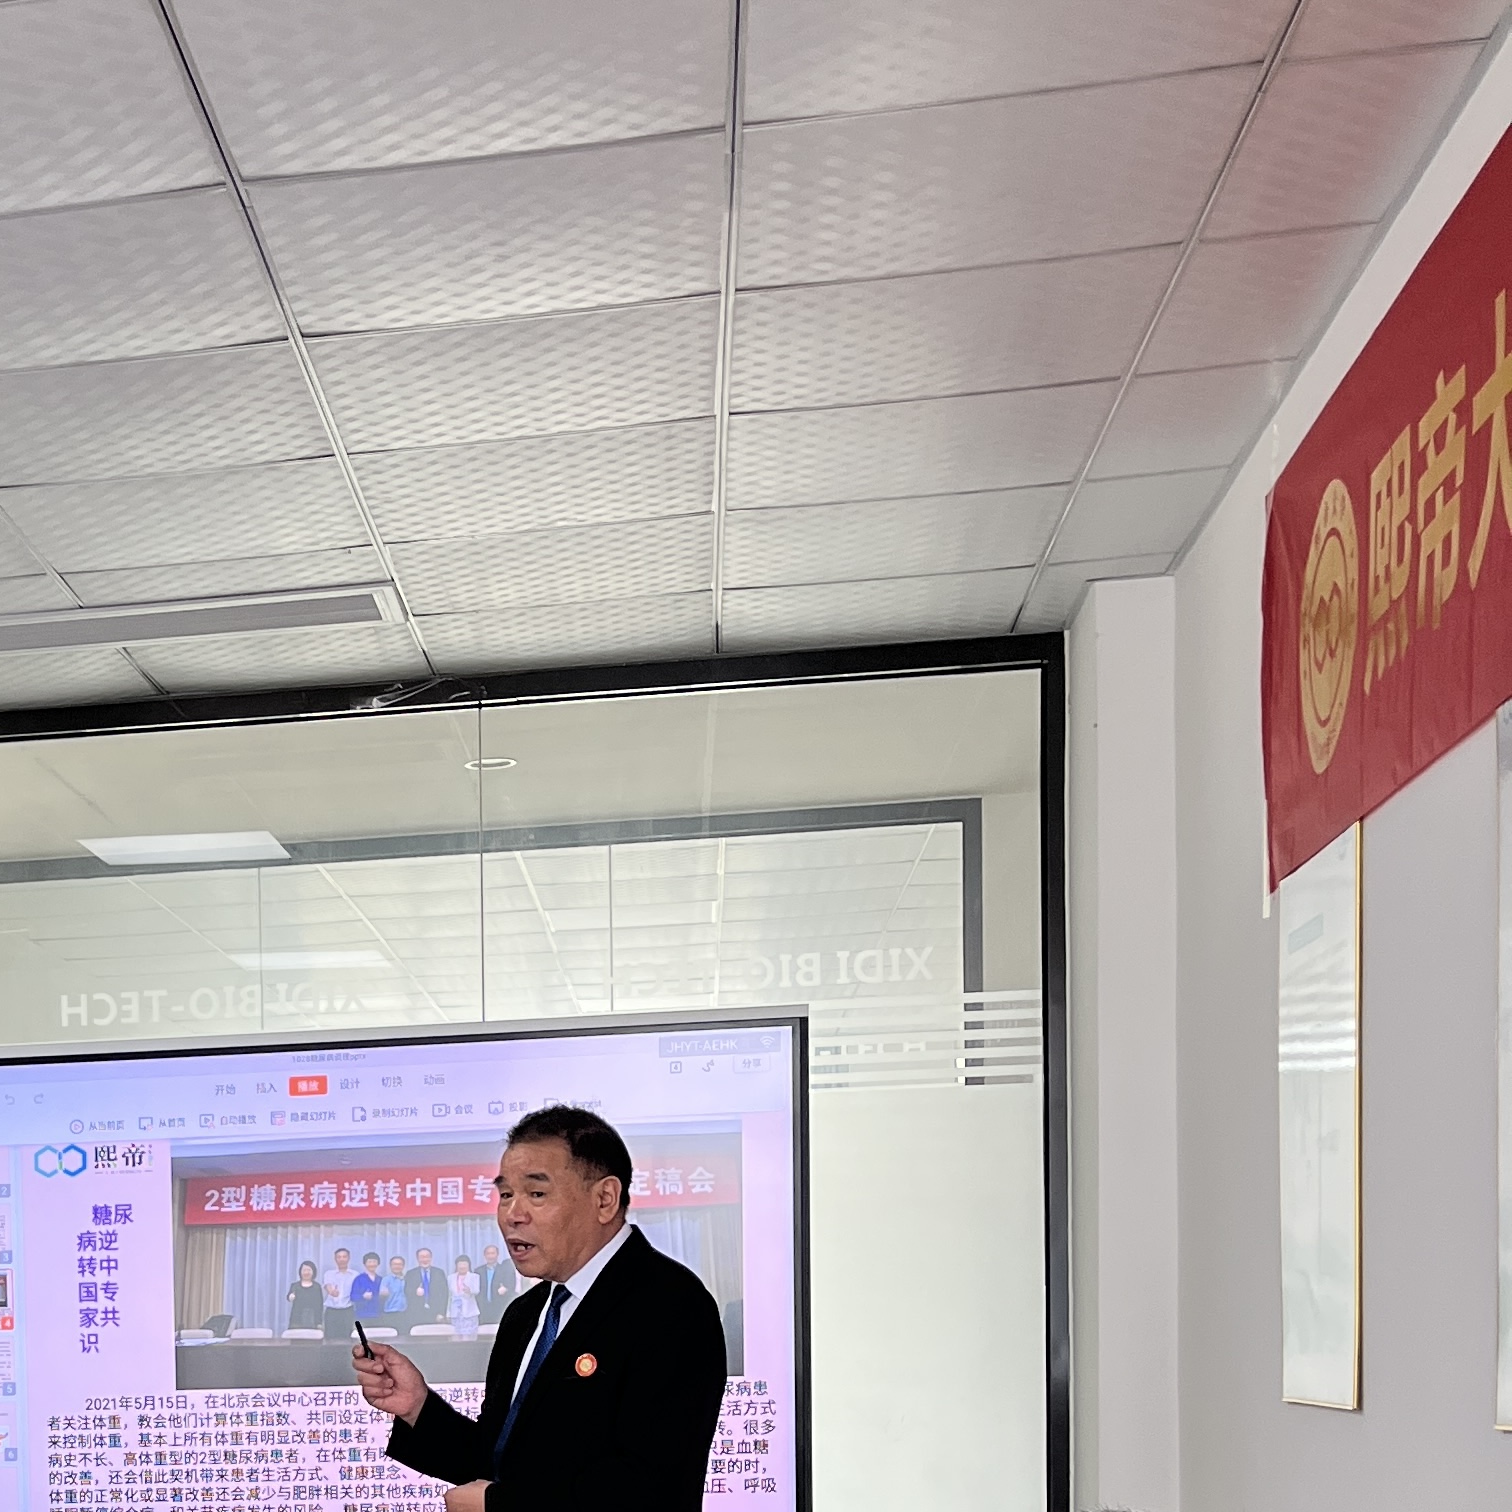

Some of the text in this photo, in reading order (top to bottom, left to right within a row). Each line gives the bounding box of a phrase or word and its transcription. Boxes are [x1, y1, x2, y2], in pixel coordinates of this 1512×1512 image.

[666, 1040, 739, 1054] JHYT-AEHK
[742, 1058, 762, 1069] 分享
[214, 1074, 445, 1096] 开始 插入 播放 设计 切换 动画
[89, 1119, 125, 1131] 从当前页
[158, 1117, 186, 1128] 从首页
[220, 1114, 257, 1126] 自动播放
[290, 1110, 337, 1123] 隐藏幻灯片
[372, 1106, 419, 1118] 录制幻灯片
[455, 1104, 473, 1115] 会议
[94, 1143, 147, 1169] 熙帝
[204, 1166, 716, 1212] 2型糖尿病逆转中国专 定稿会
[92, 1203, 134, 1226] 糖尿
[77, 1230, 120, 1252] 病逆
[77, 1255, 119, 1278] 转中
[79, 1281, 120, 1303] 国专
[79, 1306, 121, 1329] 家共
[80, 1333, 100, 1354] 识
[49, 1458, 767, 1486] 的改善，还会借此契机带来患者生活方式、健康理念、 要的时，
